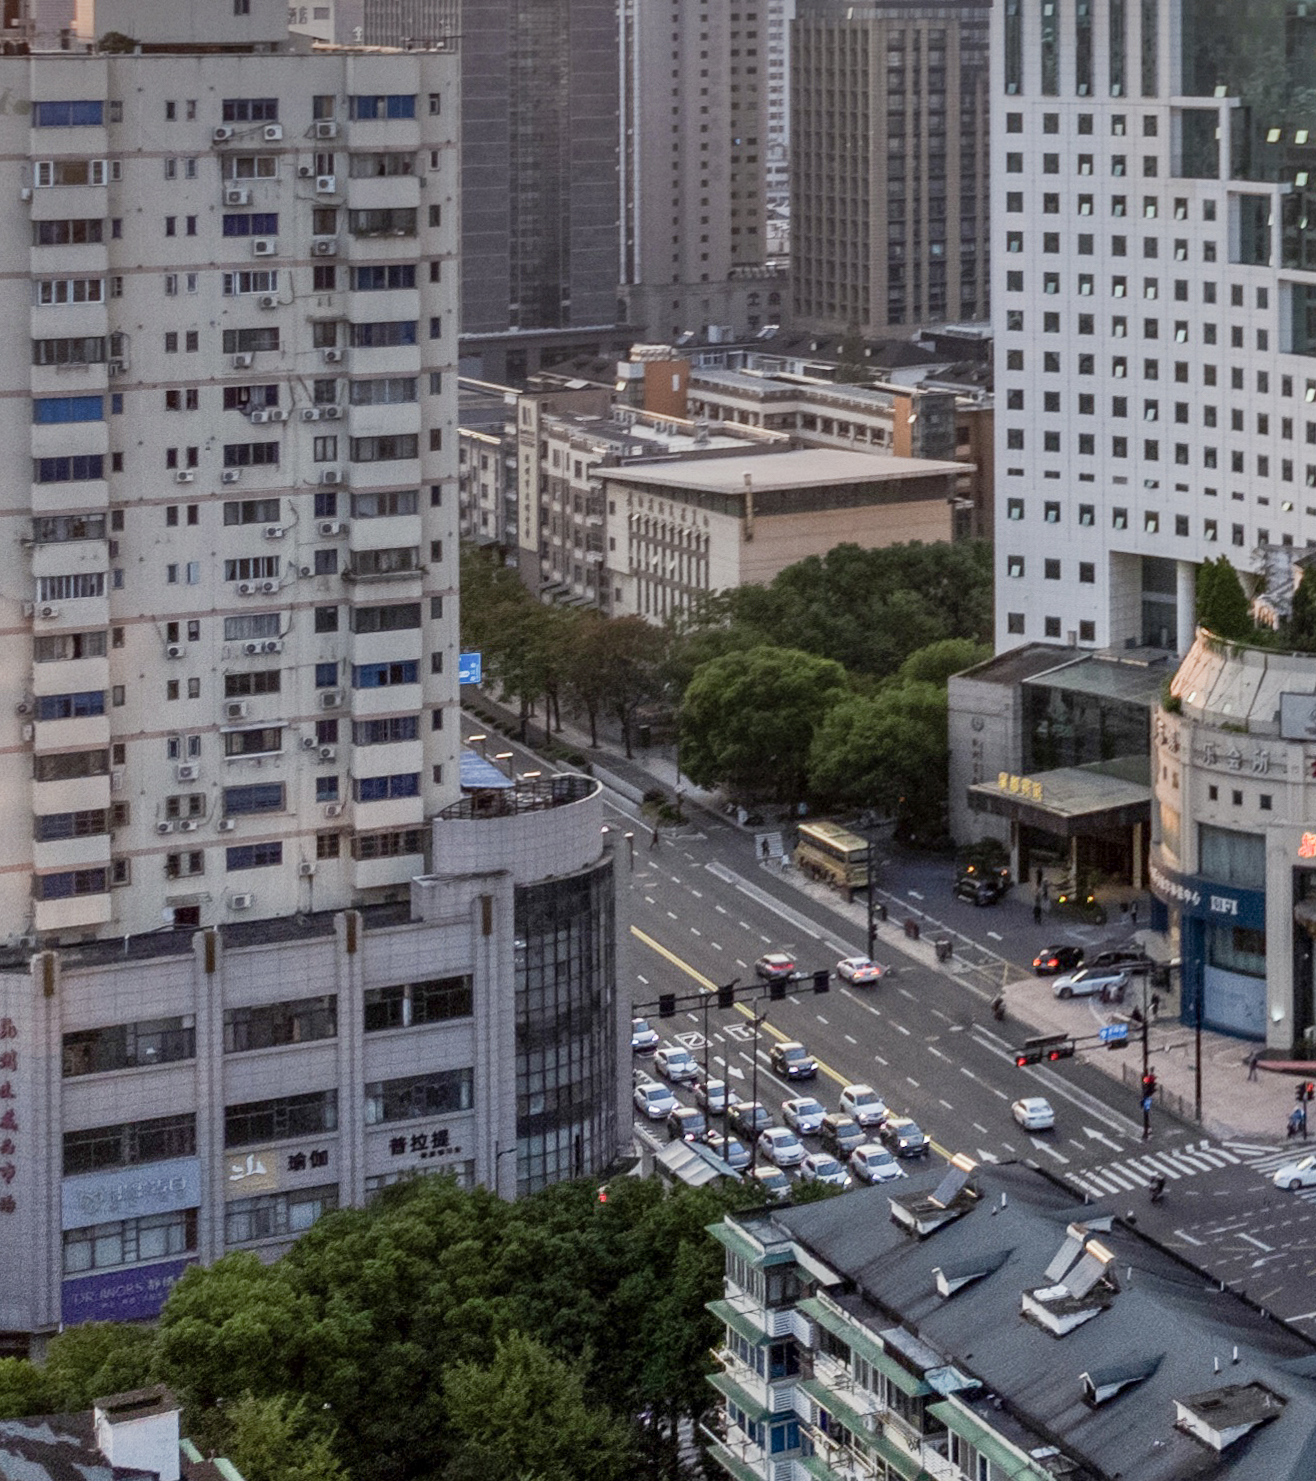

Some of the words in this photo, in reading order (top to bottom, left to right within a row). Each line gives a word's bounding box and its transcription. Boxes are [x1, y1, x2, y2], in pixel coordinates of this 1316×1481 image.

[389, 1129, 449, 1156] 普拉提
[287, 1150, 328, 1172] 瑜伽
